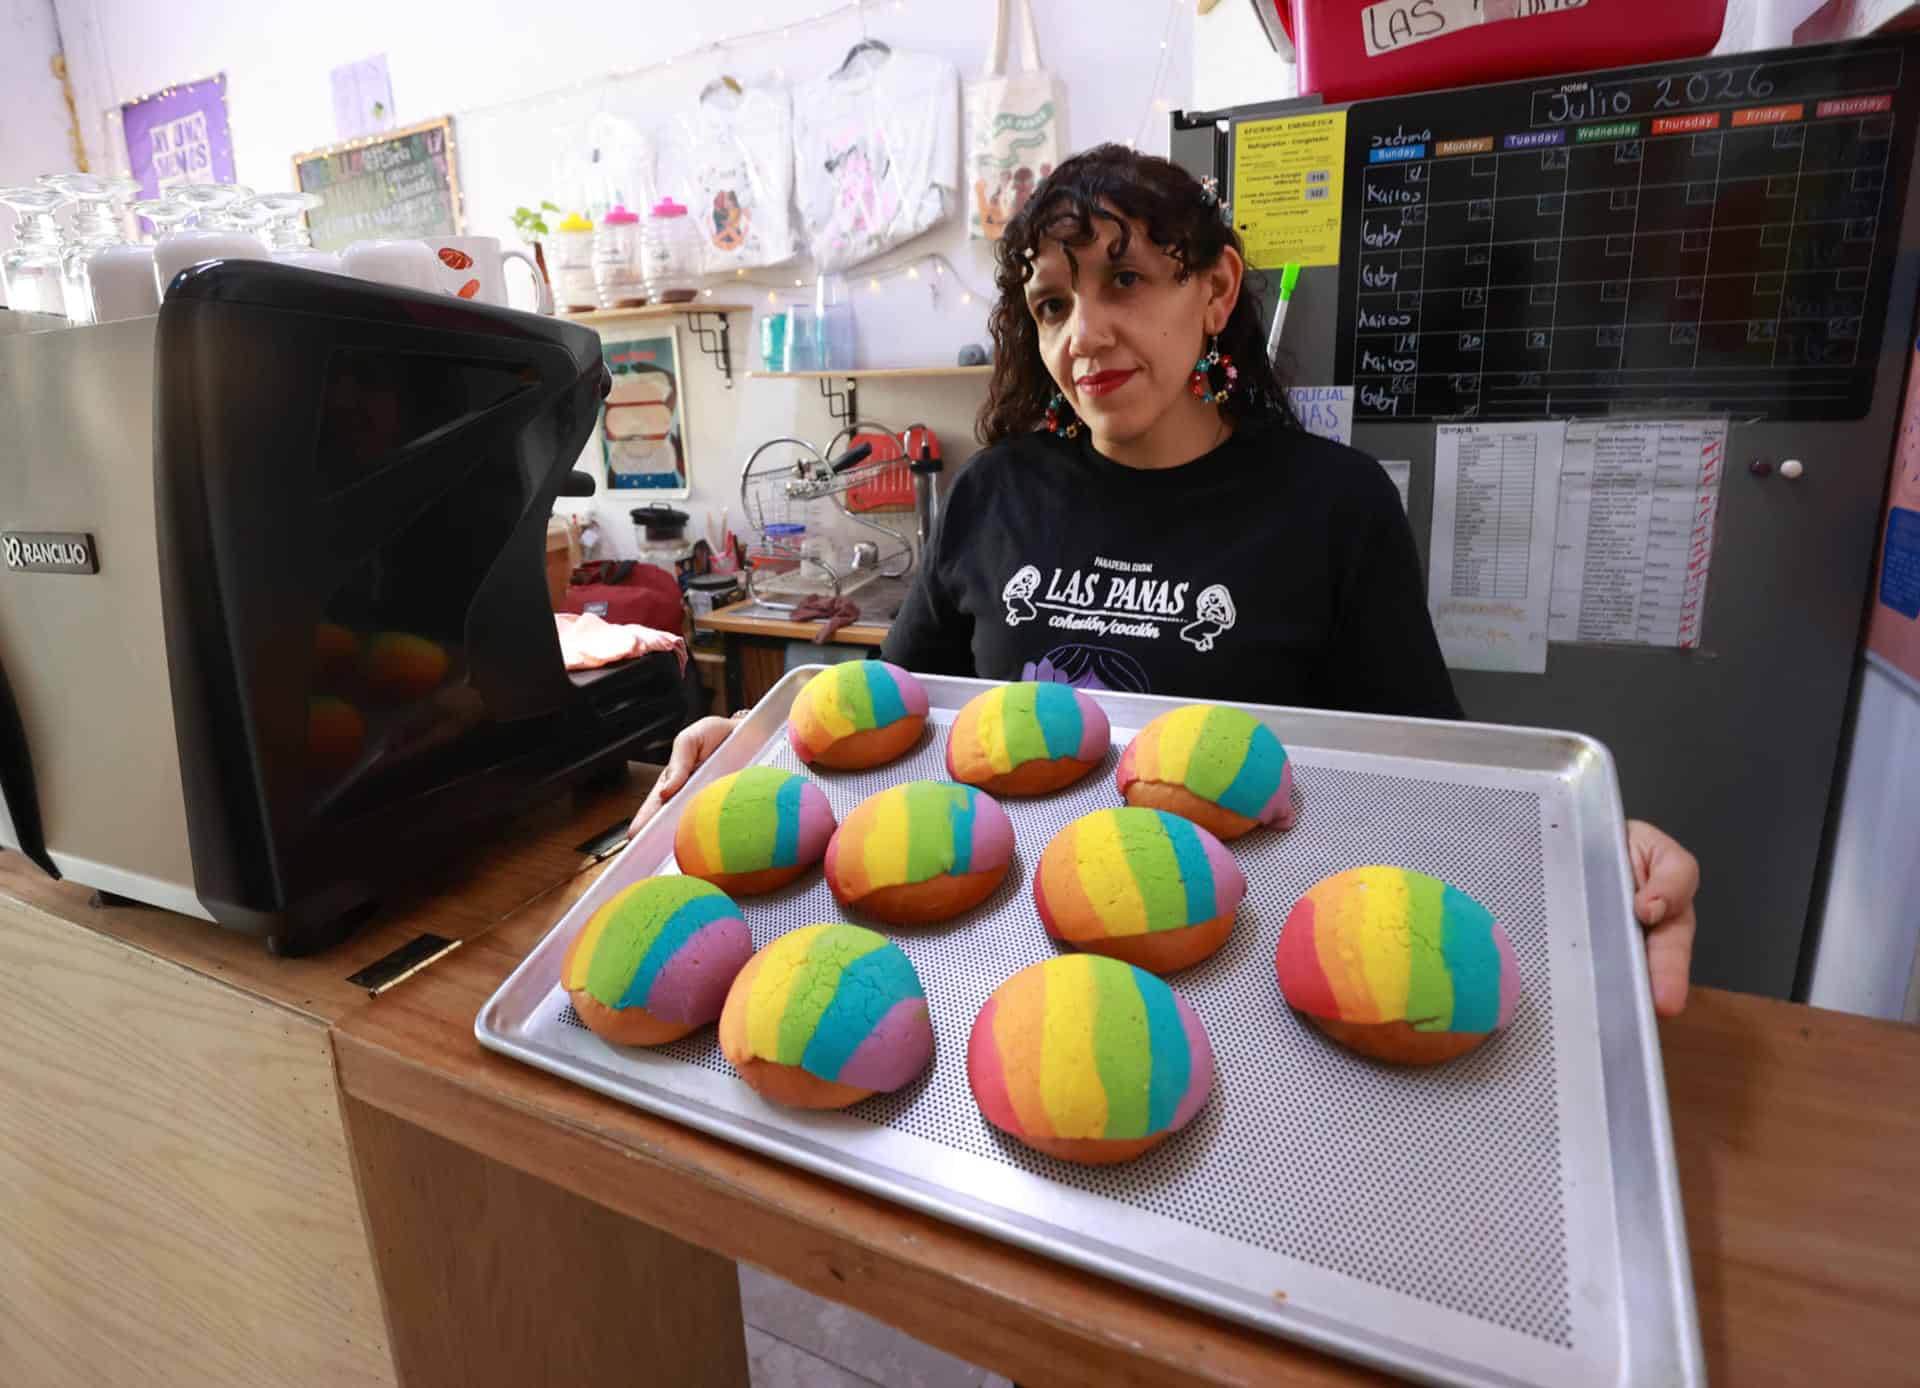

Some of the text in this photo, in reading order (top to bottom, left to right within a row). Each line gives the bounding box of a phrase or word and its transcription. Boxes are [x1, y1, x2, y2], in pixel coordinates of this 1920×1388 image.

[1369, 0, 1446, 49] LAS
[1548, 64, 1775, 121] Julio 2026
[1561, 81, 1589, 94] notes
[1377, 97, 1883, 161] Sunday Monday Tuesday Wednesday Thursday Friday Saturday
[1462, 334, 1481, 347] 20
[22, 543, 87, 564] RANCILIO
[1046, 568, 1190, 615] LAS PANAS
